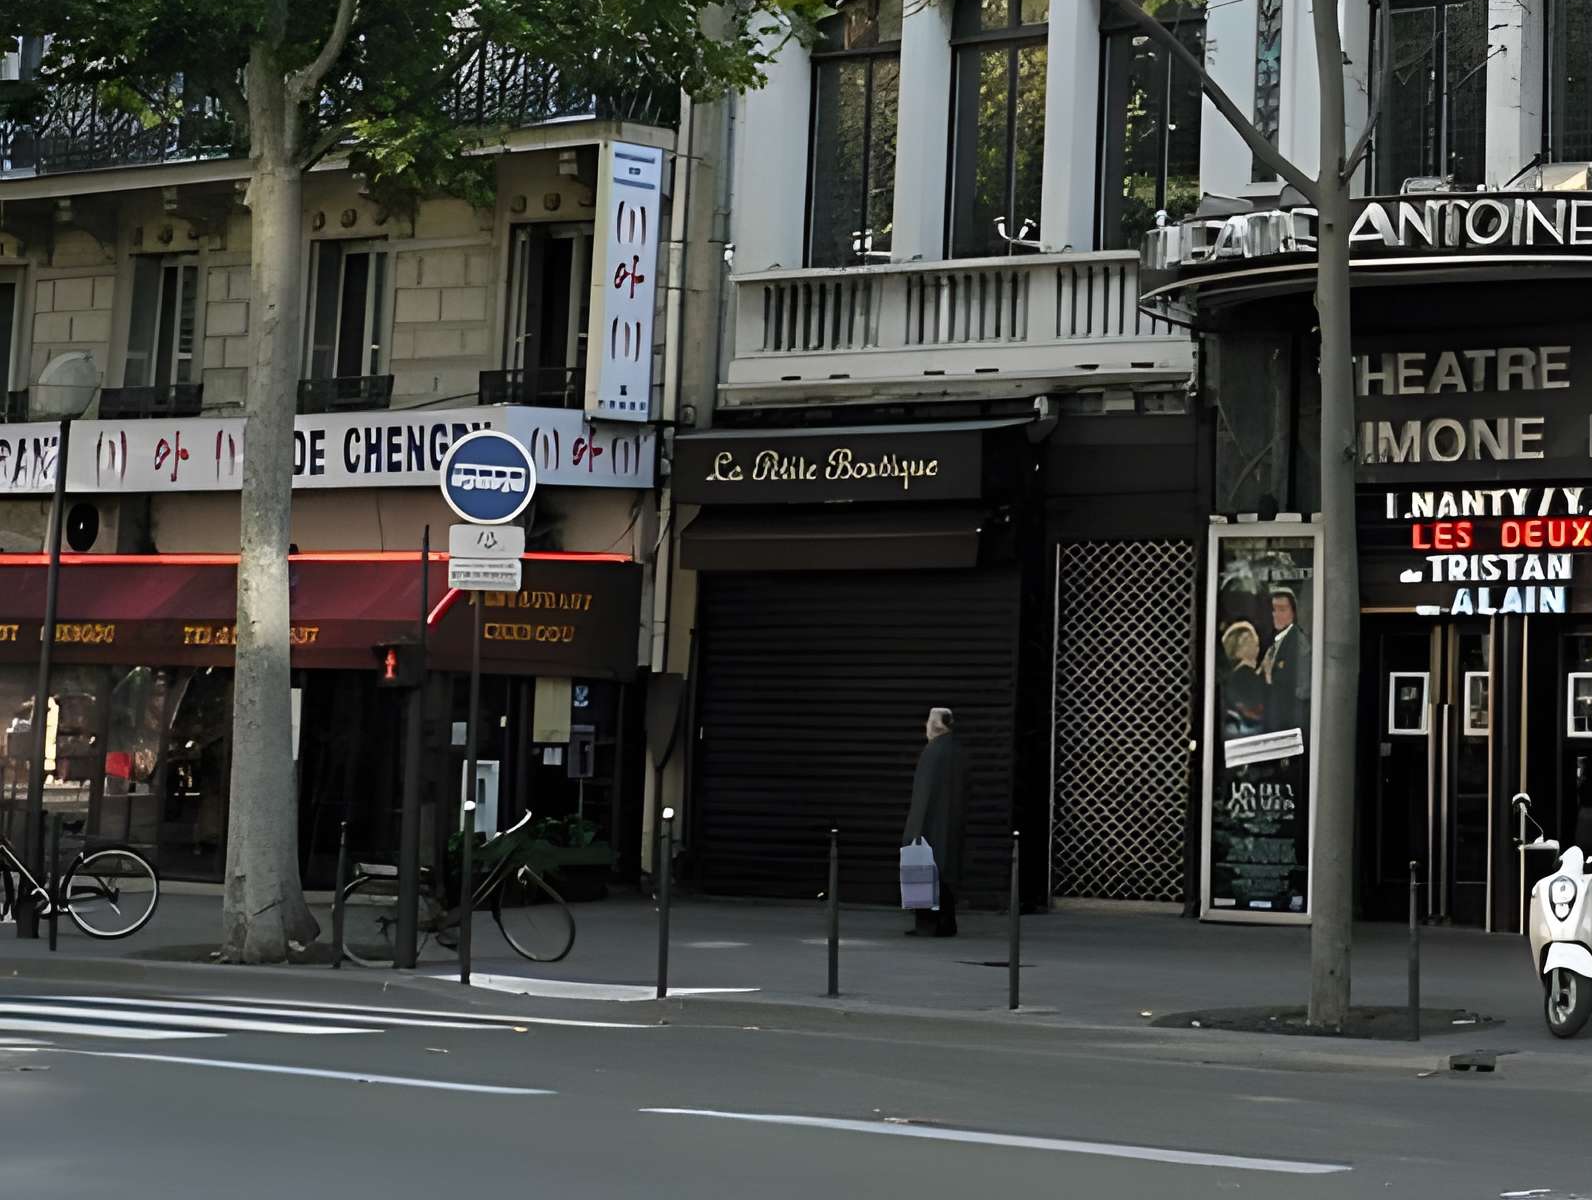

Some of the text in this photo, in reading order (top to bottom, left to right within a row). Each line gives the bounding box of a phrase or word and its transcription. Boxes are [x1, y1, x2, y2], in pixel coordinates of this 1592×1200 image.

[1352, 345, 1571, 396] HEATRE
[343, 420, 491, 475] CHENG
[1360, 416, 1544, 465] IMONE
[825, 448, 938, 490] Boutique
[1411, 523, 1473, 550] LES
[1425, 552, 1573, 582] TRISTAN
[1450, 586, 1567, 617] ALAIN
